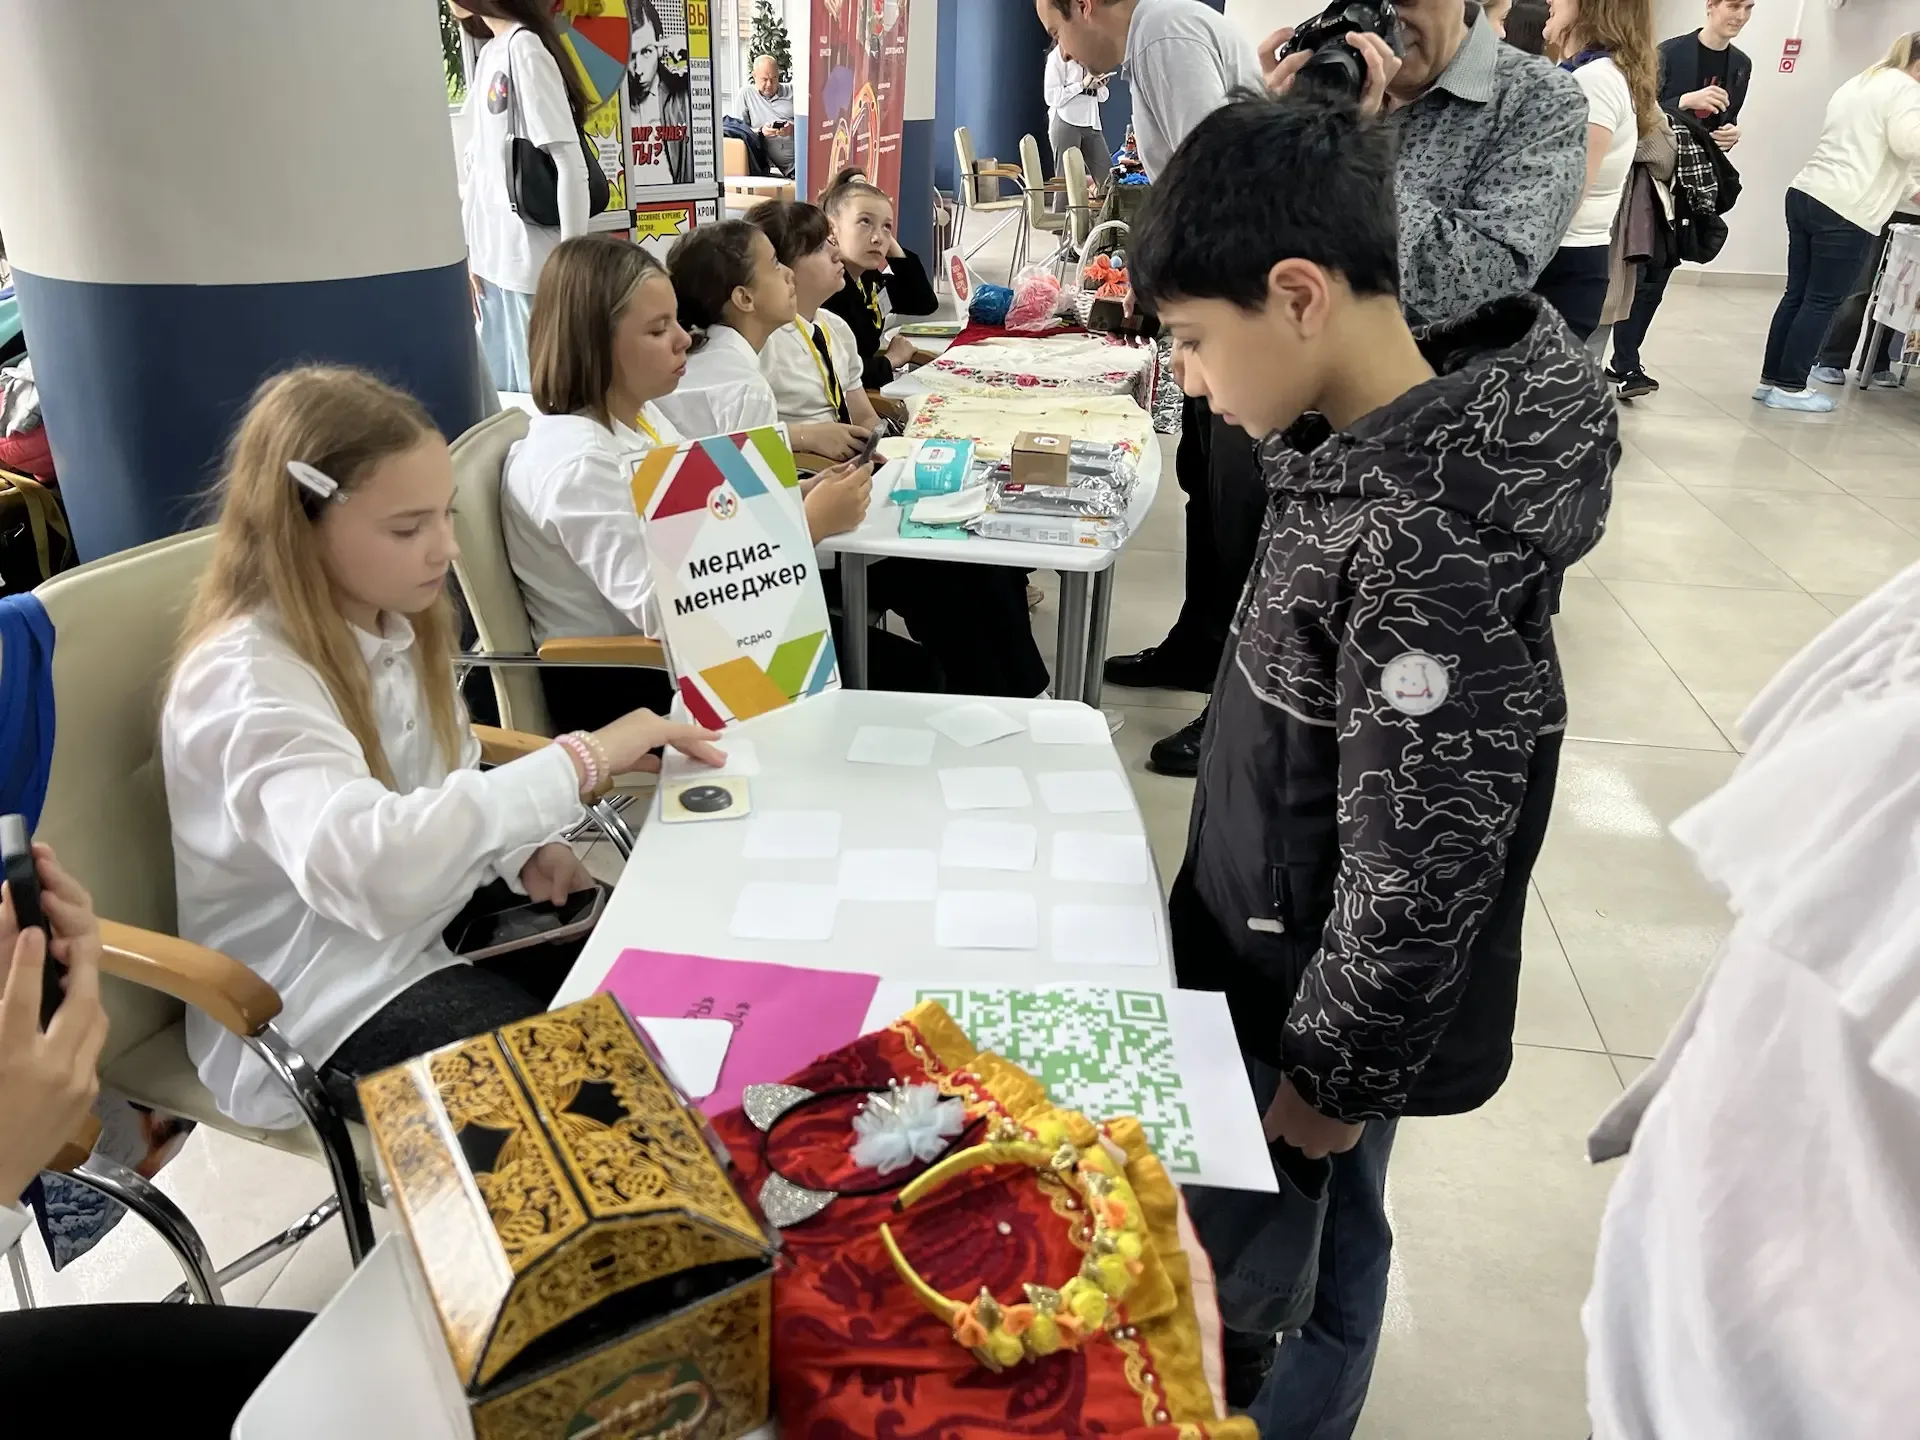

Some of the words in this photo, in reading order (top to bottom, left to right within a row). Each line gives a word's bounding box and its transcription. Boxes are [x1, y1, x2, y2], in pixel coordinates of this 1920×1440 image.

[688, 4, 708, 26] ВЫ
[1321, 16, 1343, 28] SONY
[691, 87, 711, 97] СМОЛА
[697, 206, 715, 217] ХРОМ
[688, 541, 781, 580] медиа-
[674, 562, 808, 616] менеджер
[736, 629, 773, 649] РСДМО
